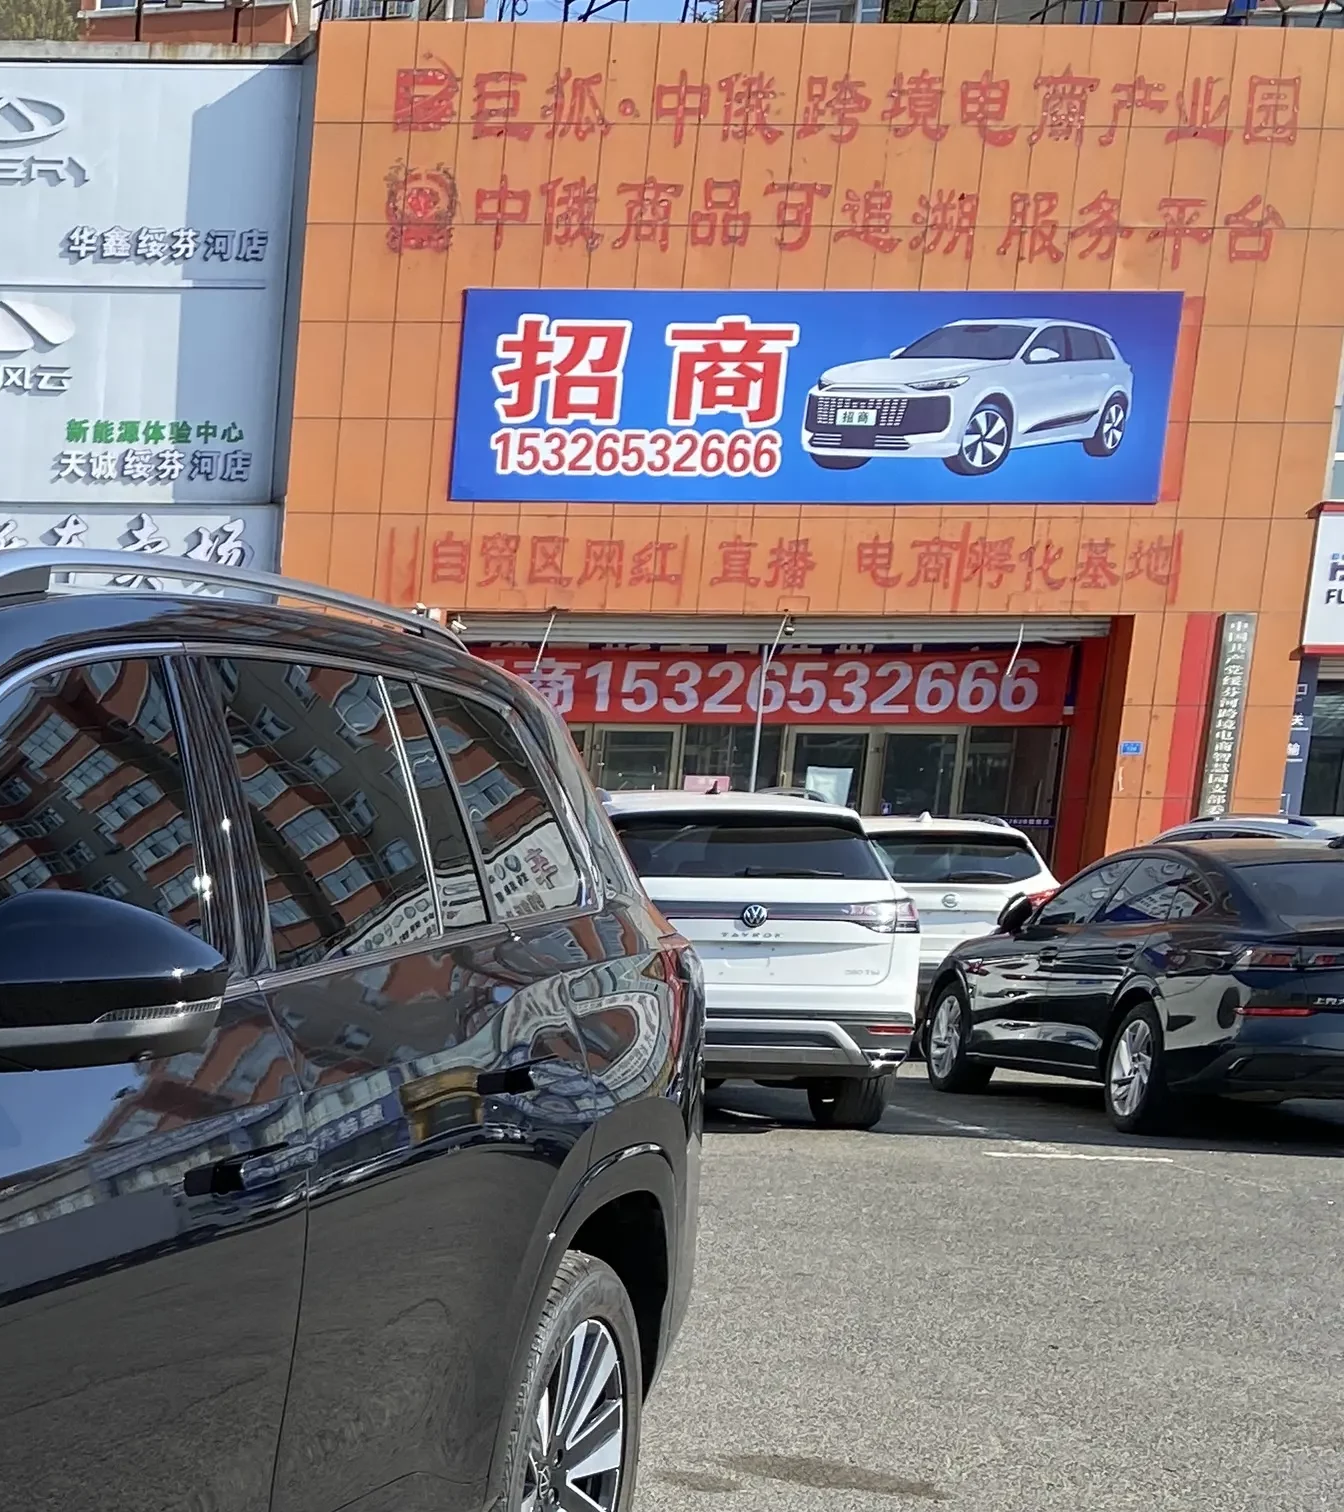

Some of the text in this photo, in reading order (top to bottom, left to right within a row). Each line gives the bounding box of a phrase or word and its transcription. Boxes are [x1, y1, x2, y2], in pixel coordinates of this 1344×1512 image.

[65, 226, 269, 262] 华鑫绥芬河店
[493, 312, 800, 426] 招商
[67, 418, 245, 446] 新能源体验中心
[490, 428, 782, 477] 15326532666
[57, 449, 252, 483] 天诚绥芬河店
[710, 535, 816, 590] 直播
